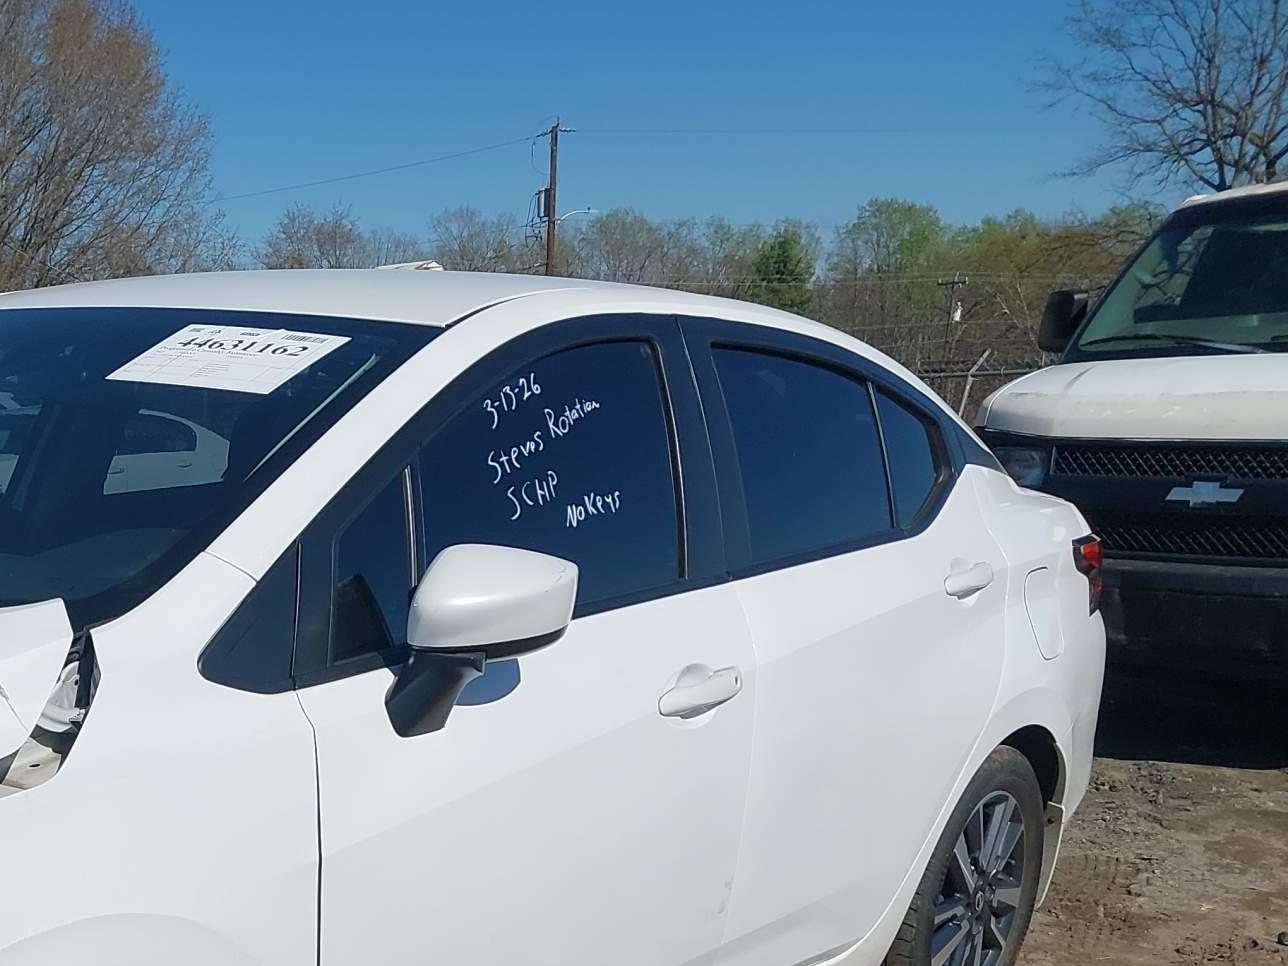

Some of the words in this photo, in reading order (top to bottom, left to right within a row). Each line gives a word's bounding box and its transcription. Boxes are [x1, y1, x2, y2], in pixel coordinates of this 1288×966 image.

[177, 336, 310, 357] 44631162
[483, 372, 542, 430] 3-13-26
[544, 398, 600, 438] Rotation
